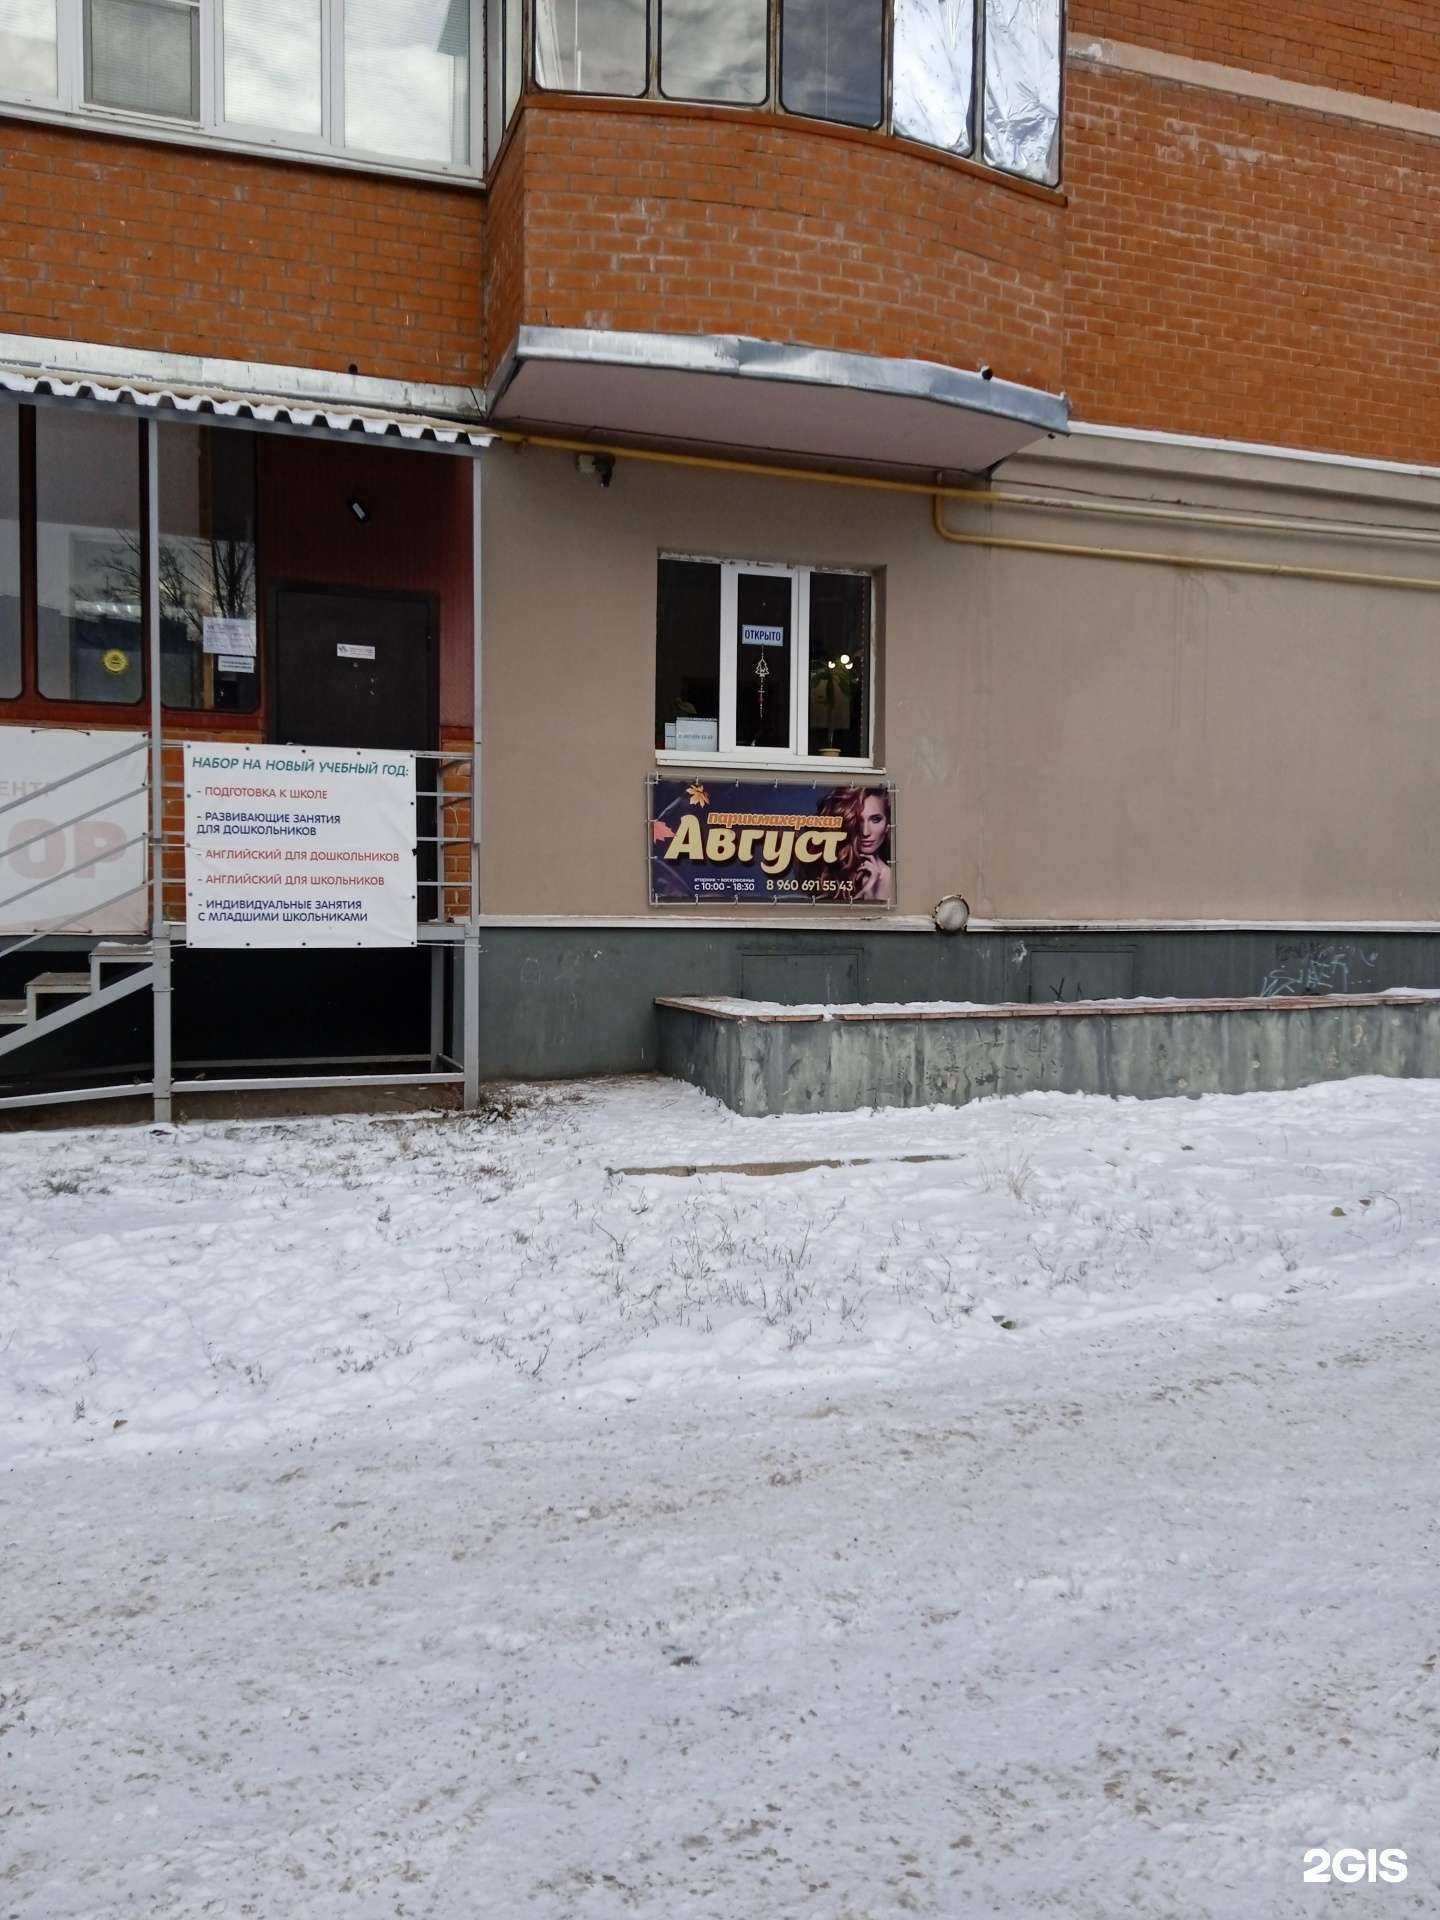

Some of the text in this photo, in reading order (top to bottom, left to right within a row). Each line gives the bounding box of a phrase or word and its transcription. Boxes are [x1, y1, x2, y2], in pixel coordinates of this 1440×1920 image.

[744, 629, 781, 641] ОТКРЫТО
[192, 757, 409, 777] НАБОР НА НОВЫЙ УЧЕБНЫЙ ГОД:
[204, 786, 276, 798] ПОДГОТОВКА
[279, 788, 287, 798] К
[290, 789, 328, 799] ШКОЛЕ
[205, 812, 290, 824] РАЗВИВАЮЩИЕ
[293, 814, 341, 824] ЗАНЯТИЯ
[706, 812, 843, 830] парикмахерская
[196, 825, 317, 836] ДЛЯ ДОШКОЛЬНИКОВ
[664, 814, 847, 874] Август
[206, 848, 282, 860] АНГЛИЙСКИЙ
[285, 851, 308, 862] ДЛЯ
[310, 851, 399, 862] ДОШКОЛЬНИКОВ
[206, 873, 282, 885] АНГЛИЙСКИЙ
[285, 876, 308, 886] ДЛЯ
[310, 876, 385, 886] ШКОЛЬНИКОВ
[766, 879, 854, 891] 8 960 691 55 43
[701, 882, 725, 891] 10:00
[733, 882, 755, 891] 18:30
[206, 899, 312, 911] ИНДИВИДУАЛЬНЫЕ
[314, 900, 362, 910] ЗАНЯТИЯ
[198, 912, 368, 922] С МЛАДШИМИ ШКОЛЬНИКАМИ
